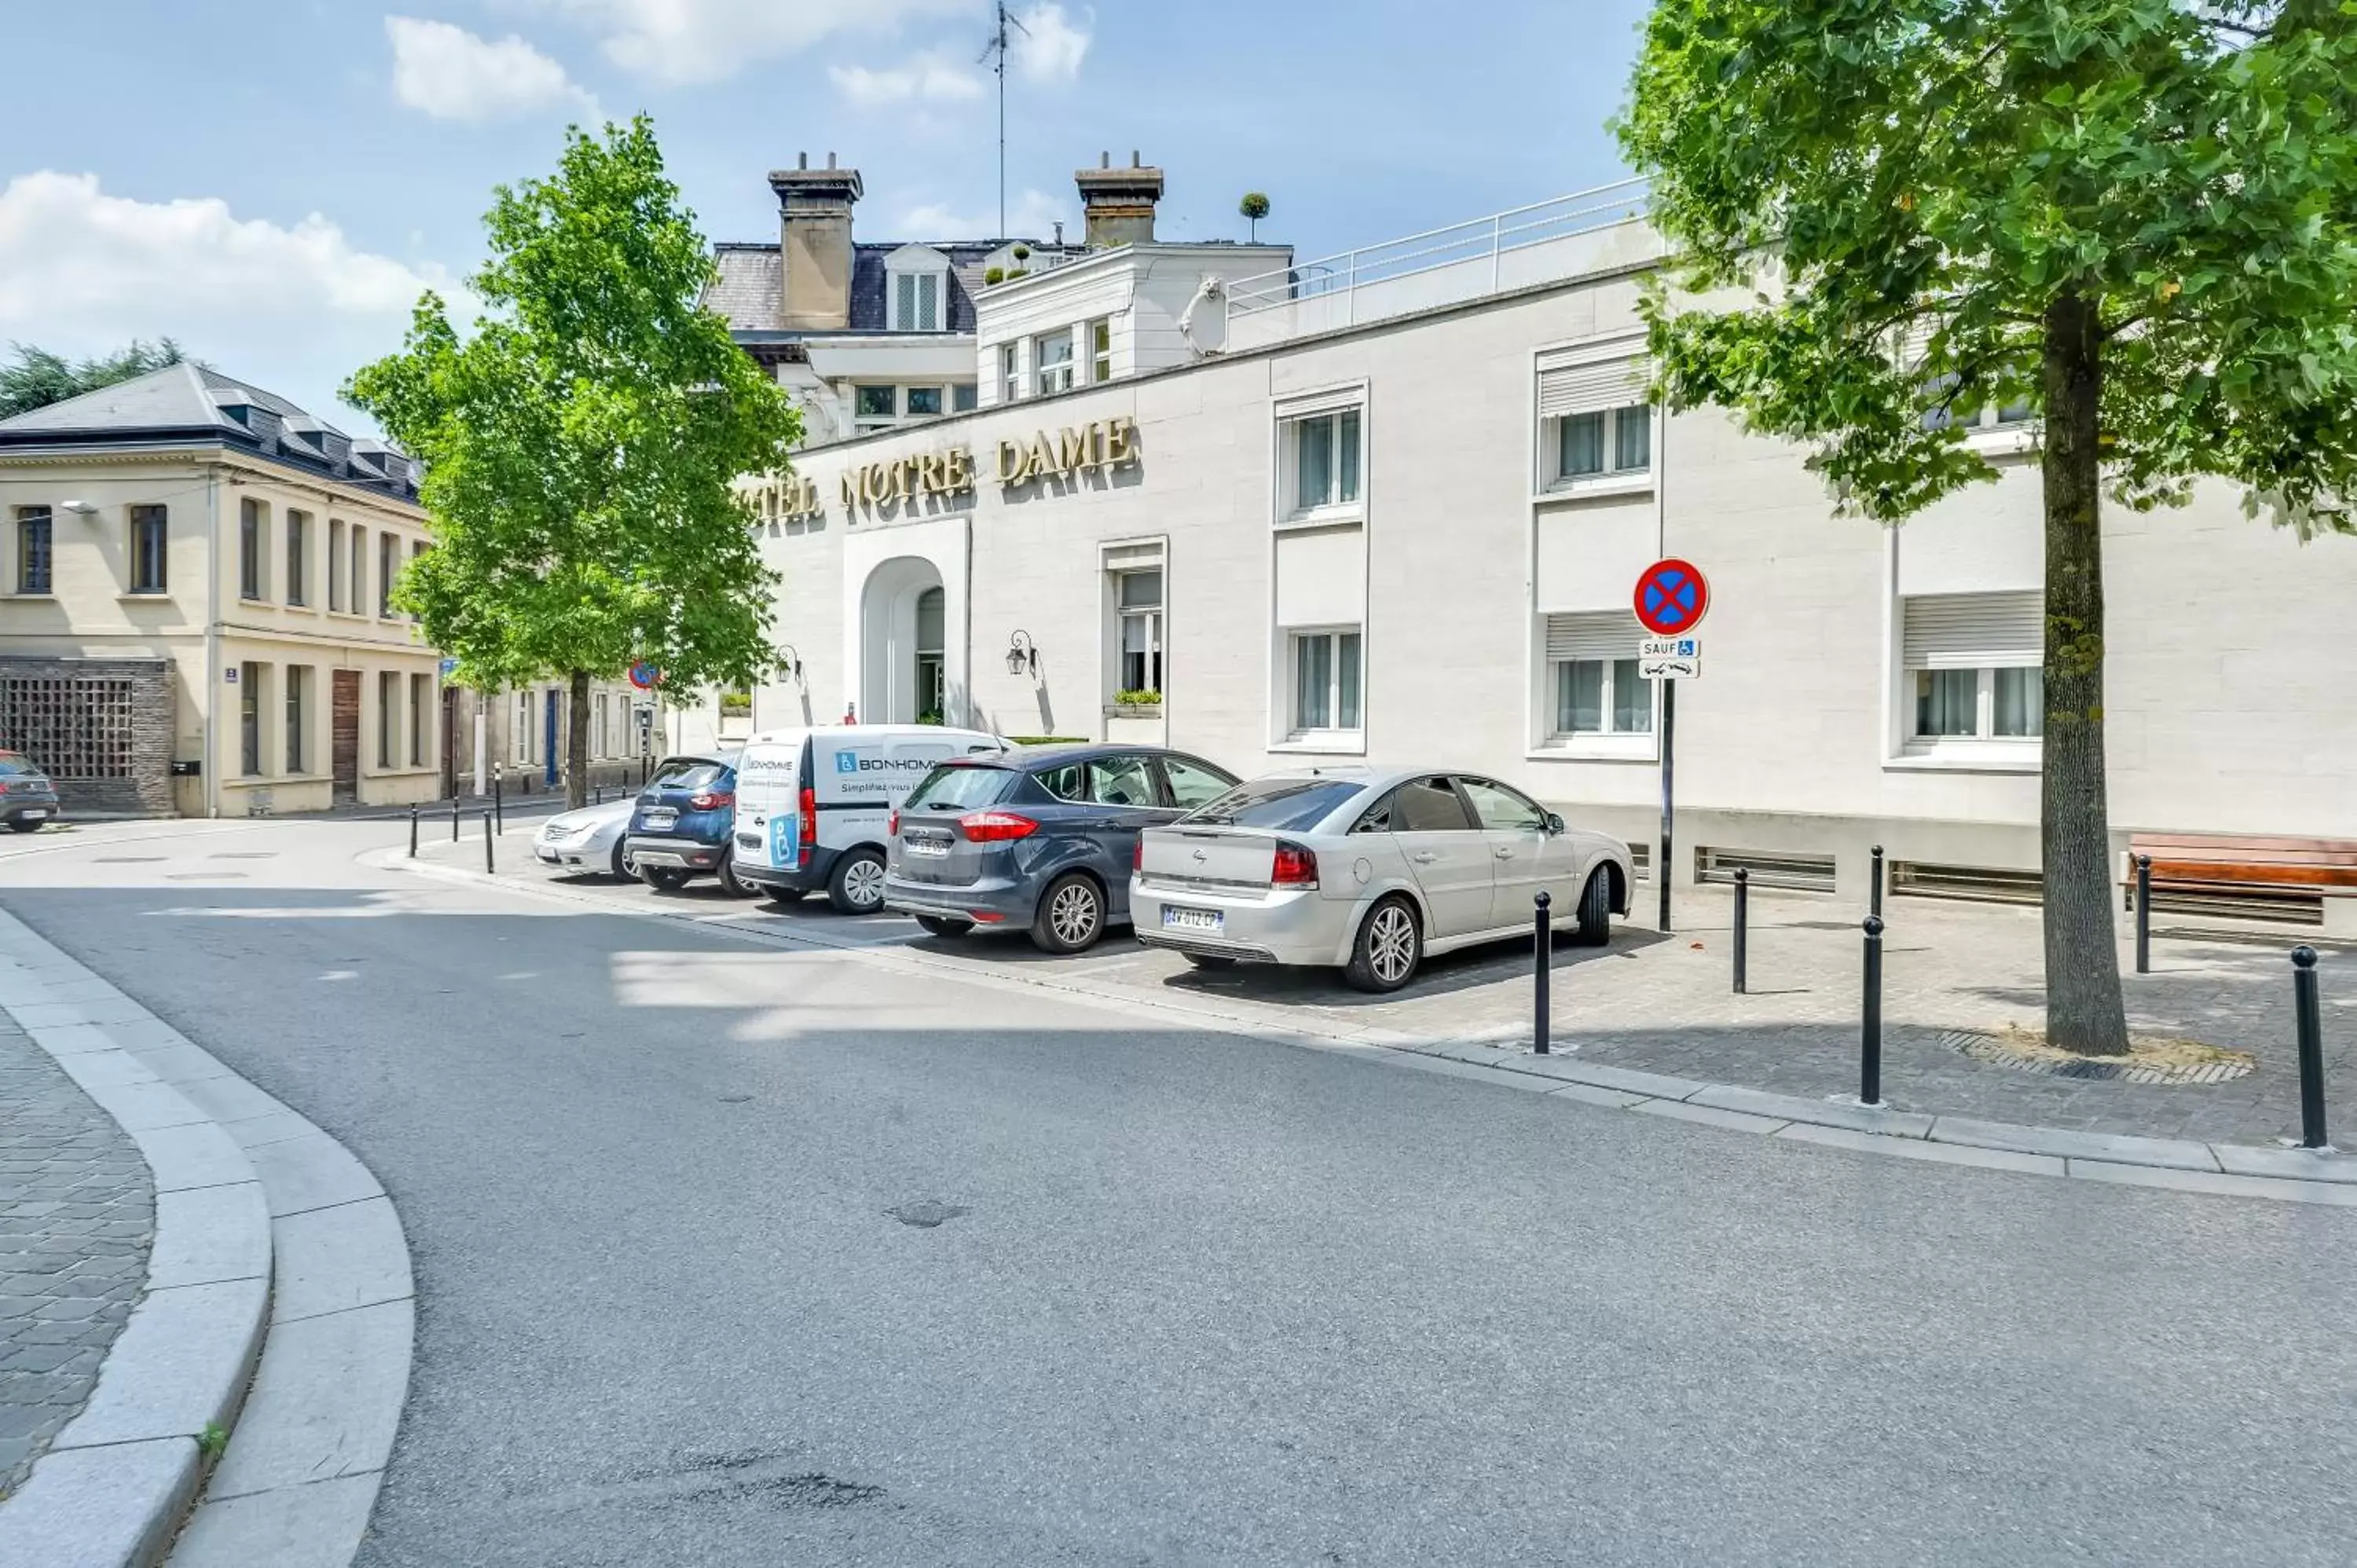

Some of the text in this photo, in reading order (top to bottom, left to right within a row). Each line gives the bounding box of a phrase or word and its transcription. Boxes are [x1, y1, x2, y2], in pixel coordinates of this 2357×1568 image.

[840, 446, 975, 508] NOTRE
[995, 416, 1135, 482] DAME
[1644, 643, 1676, 654] SAUF
[859, 759, 935, 771] BONHOM
